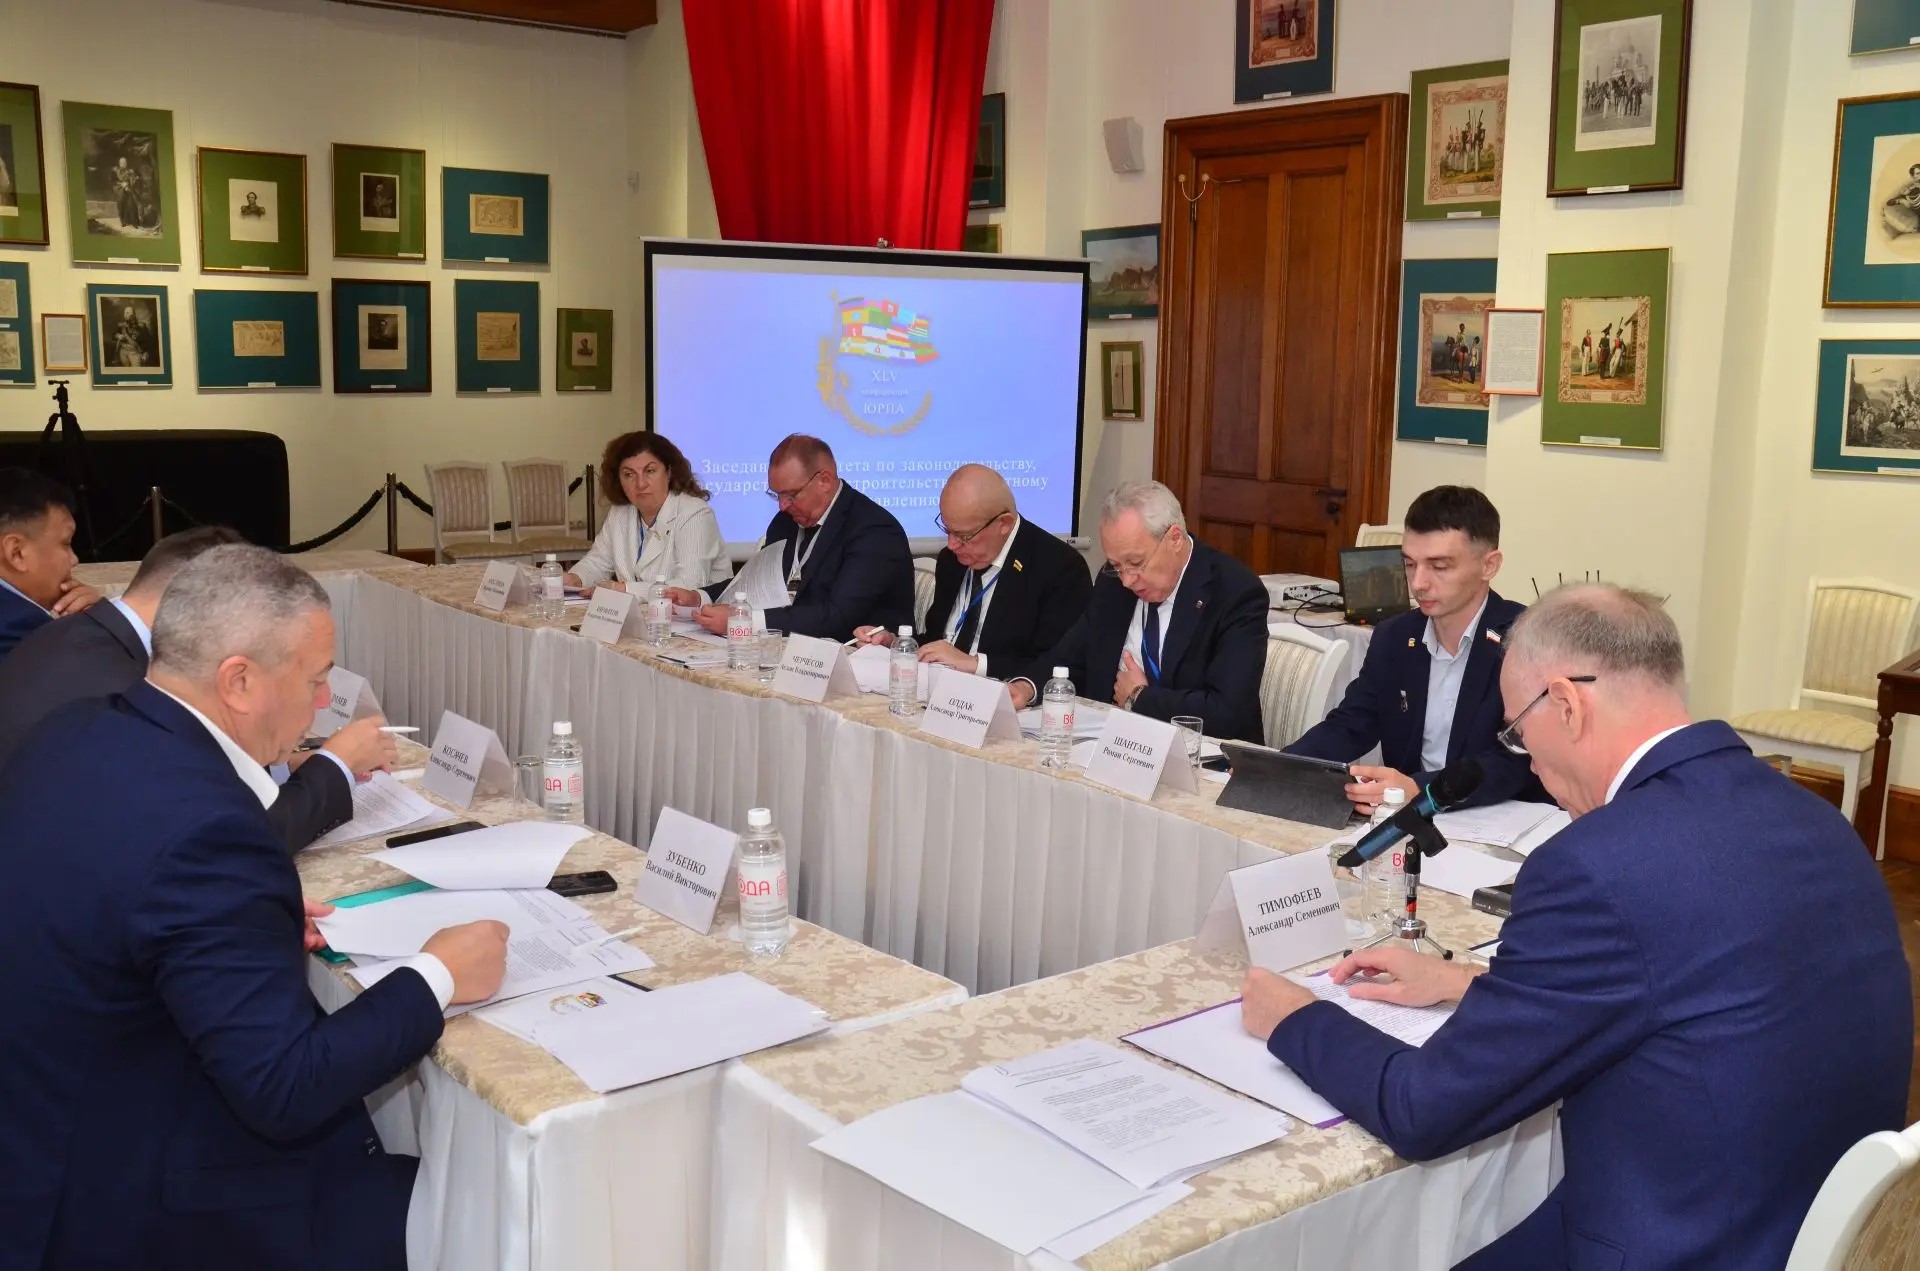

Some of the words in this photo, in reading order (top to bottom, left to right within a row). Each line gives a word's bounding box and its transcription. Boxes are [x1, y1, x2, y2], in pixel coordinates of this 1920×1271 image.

[872, 369, 898, 382] XLV
[702, 459, 768, 474] Заседан
[876, 460, 895, 472] по
[1114, 736, 1153, 757] ШАНТАЕВ
[1103, 747, 1122, 759] Роман
[1122, 752, 1155, 771] Сергеевич
[665, 850, 706, 876] ЗУБЕНКО
[645, 860, 675, 881] Василий
[675, 872, 717, 900] Викторович
[738, 873, 771, 896] ОДА
[1258, 887, 1322, 916] ТИМОФЕЕВ
[1248, 916, 1294, 938] Александр
[1295, 901, 1340, 922] Семенович
